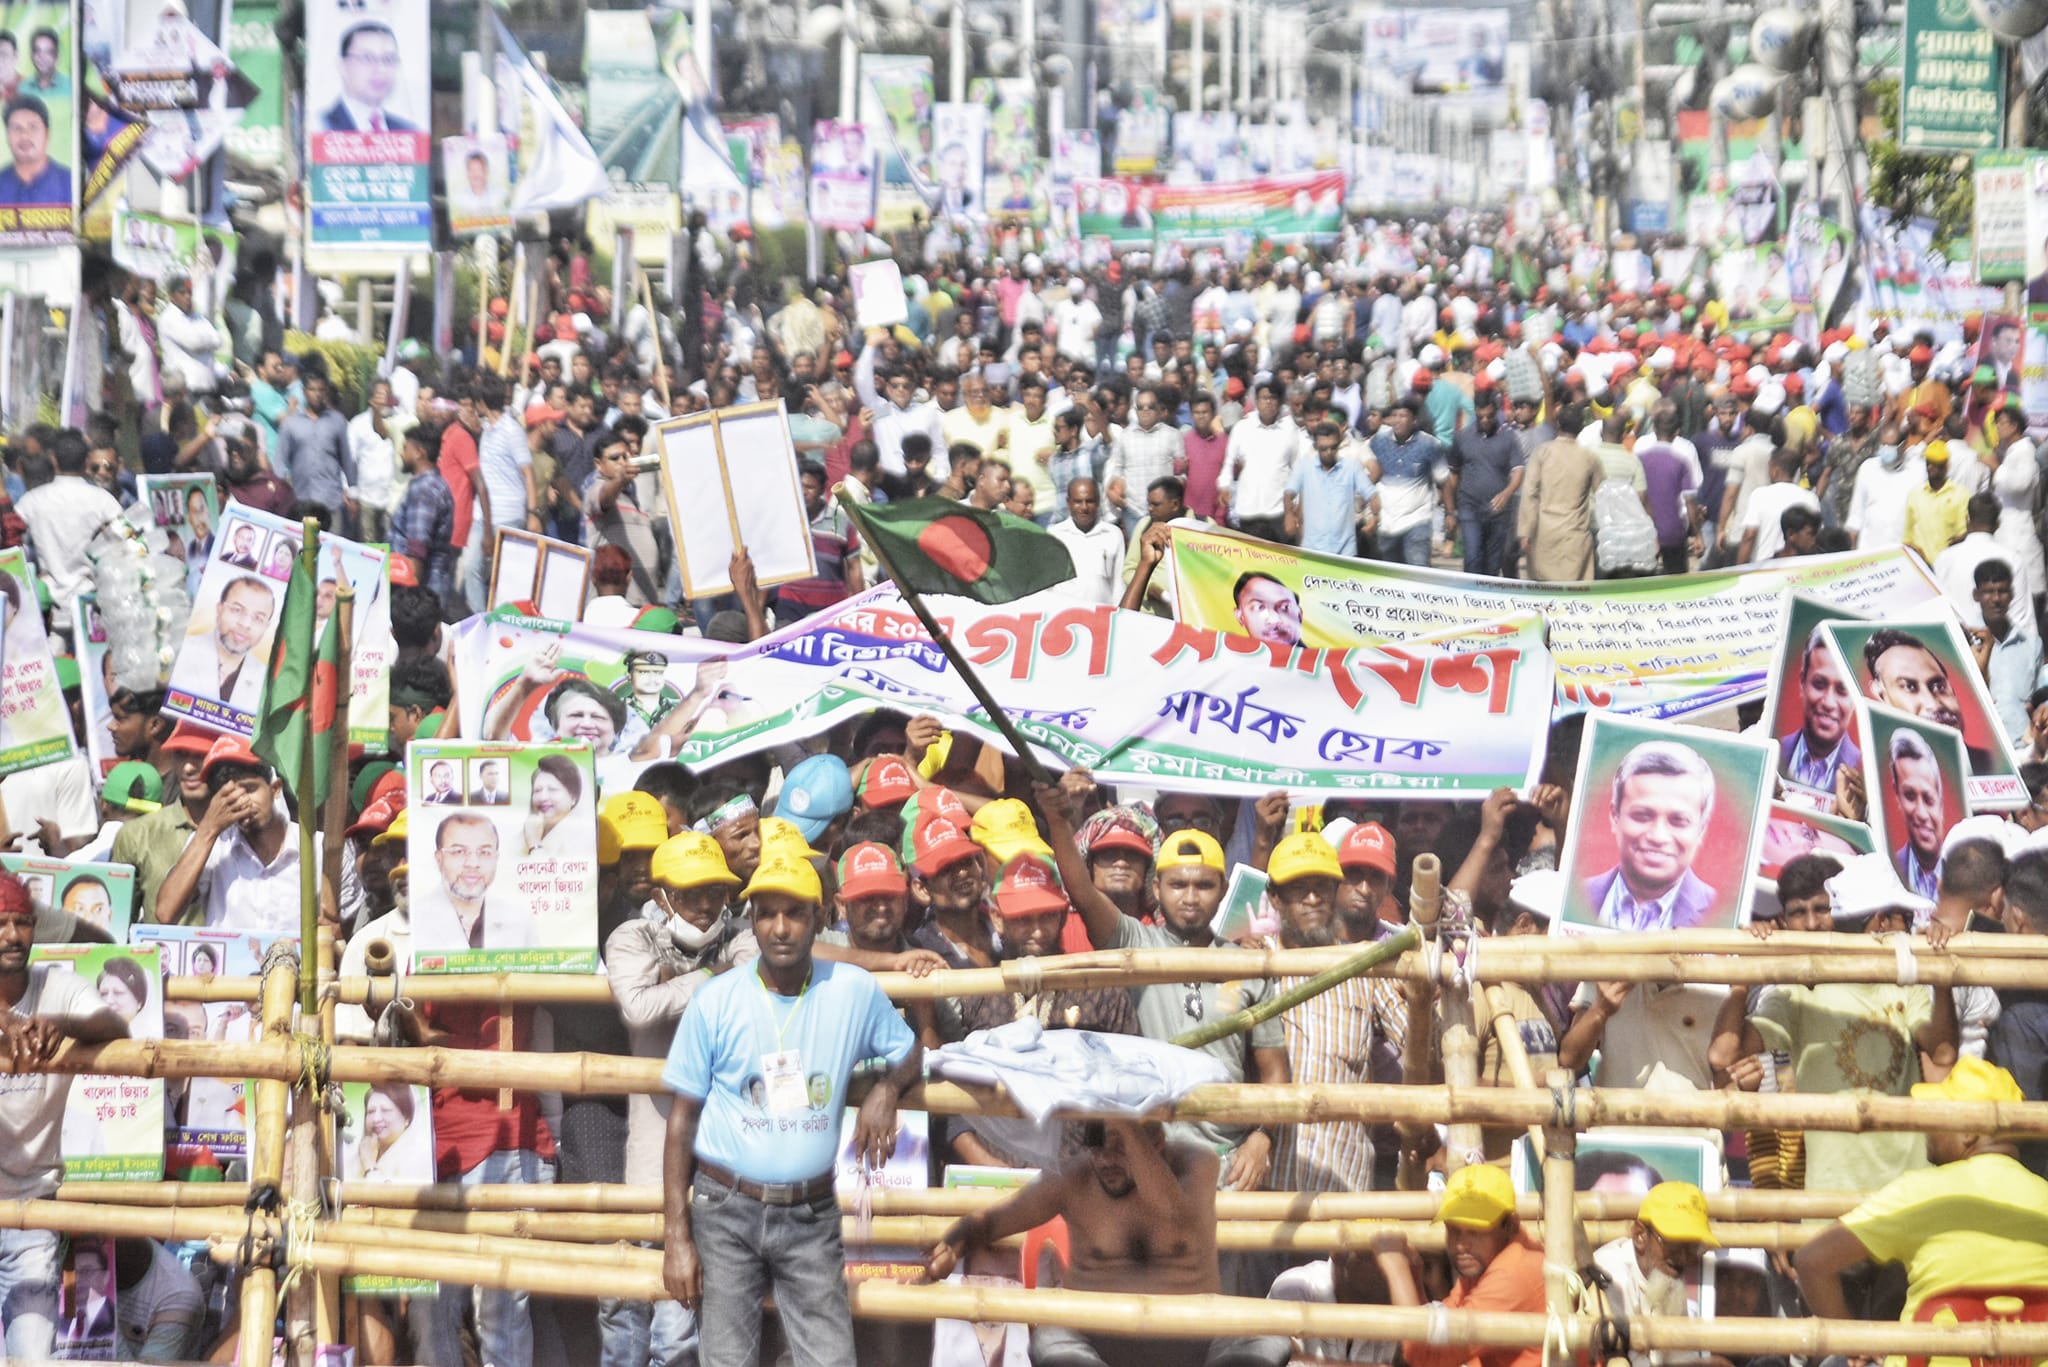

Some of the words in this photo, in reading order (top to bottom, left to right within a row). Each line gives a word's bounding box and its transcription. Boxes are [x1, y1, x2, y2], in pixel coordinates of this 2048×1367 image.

[1304, 575, 1364, 593] দেশনেত্রী
[1369, 586, 1406, 600] বেগম
[1345, 599, 1381, 619] নিত্য
[965, 604, 1119, 680] গণ
[1157, 686, 1306, 744] সার্থক
[1318, 728, 1450, 763] হোক
[517, 858, 557, 876] দেশনেত্রী
[562, 861, 589, 875] বেগম
[518, 880, 551, 894] খালেদা
[554, 877, 584, 894] জিয়ার
[530, 896, 551, 915] মুক্তি
[555, 898, 571, 913] চাই
[83, 1086, 117, 1100] খালেদা
[120, 1082, 150, 1099] জিয়ার
[95, 1102, 116, 1121] মুক্তি
[120, 1103, 138, 1119] চাই
[778, 1116, 798, 1132] উপ
[801, 1113, 830, 1133] কমিটি
